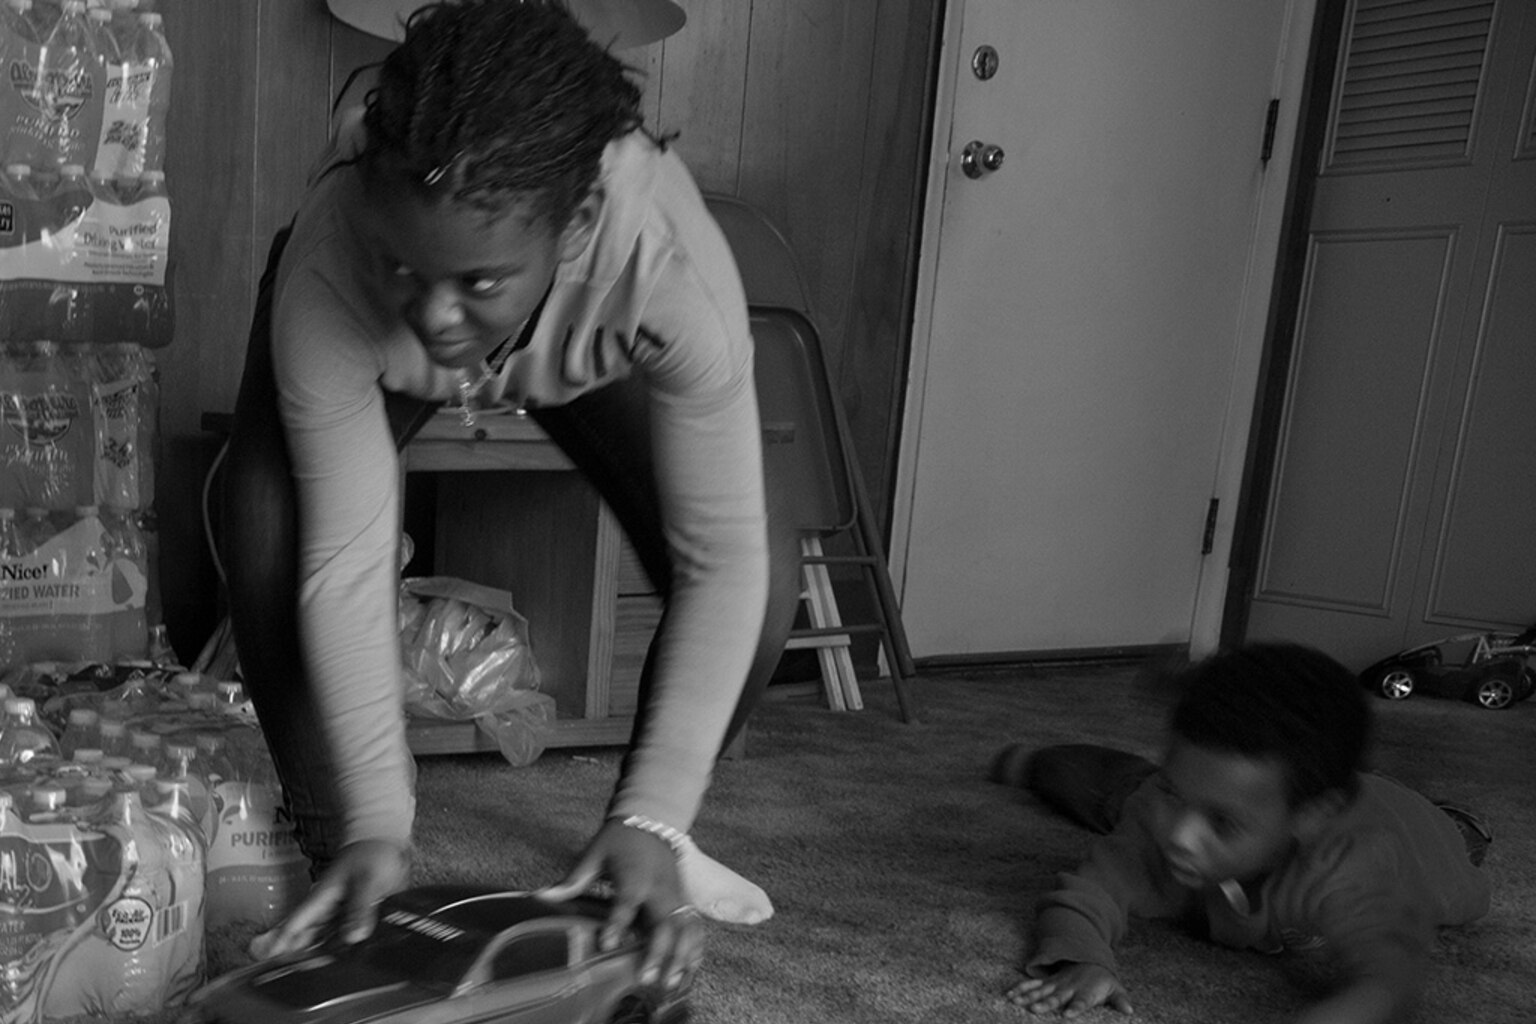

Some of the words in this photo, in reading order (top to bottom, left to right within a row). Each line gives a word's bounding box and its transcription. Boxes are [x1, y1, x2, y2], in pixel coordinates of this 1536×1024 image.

[108, 222, 158, 237] Purified
[1, 563, 48, 580] Nice!
[33, 584, 80, 599] WATER
